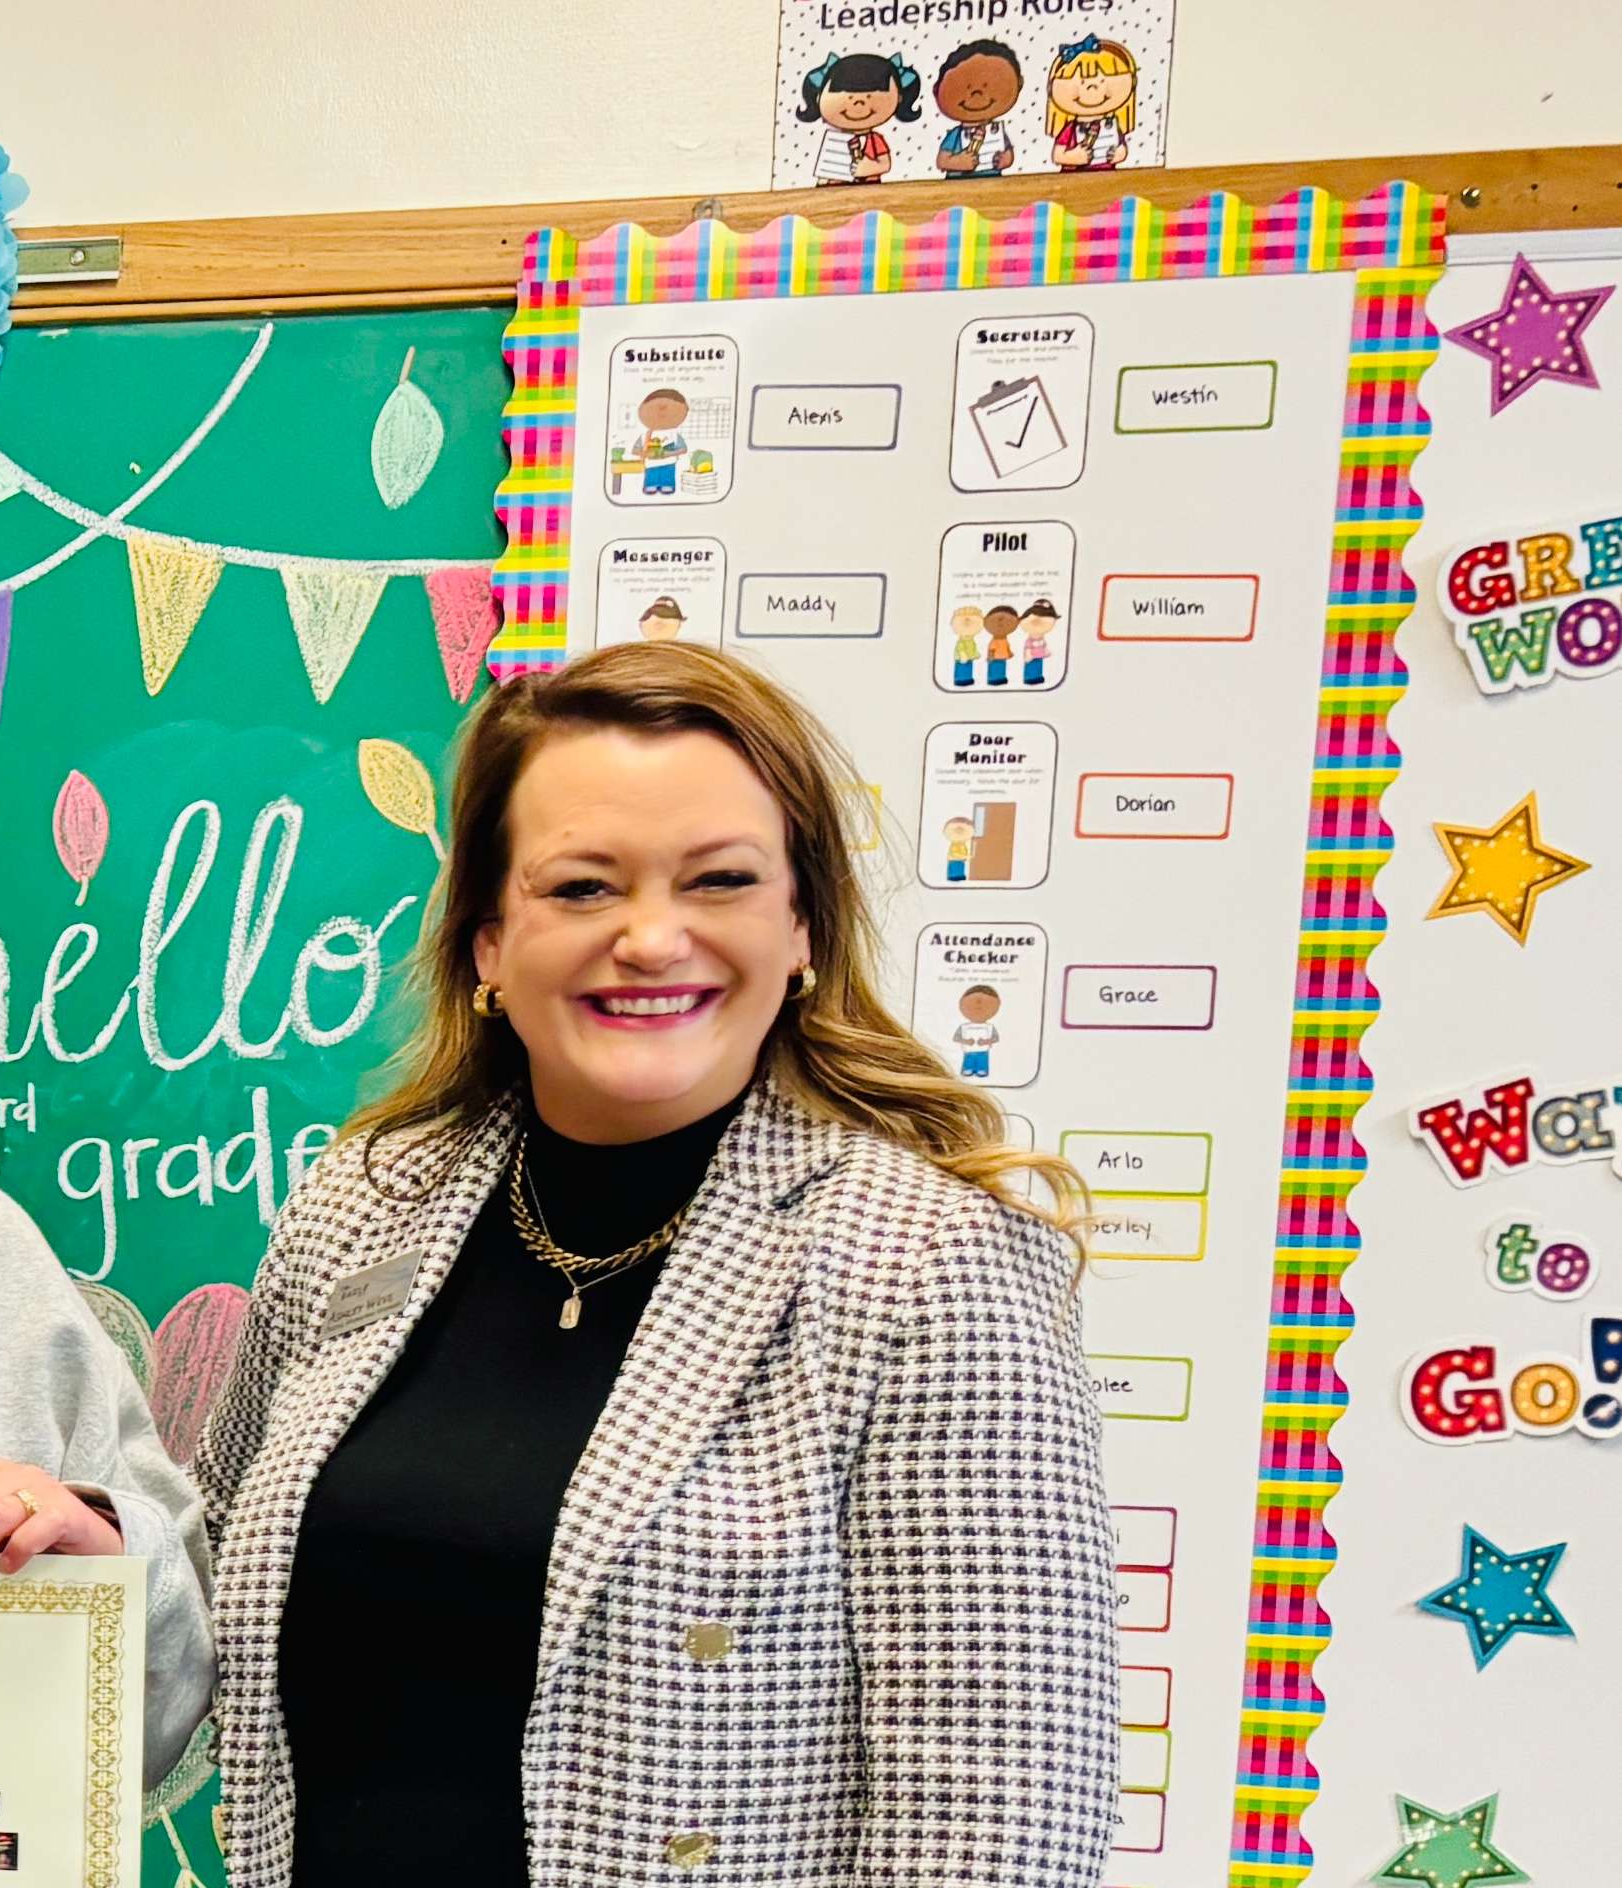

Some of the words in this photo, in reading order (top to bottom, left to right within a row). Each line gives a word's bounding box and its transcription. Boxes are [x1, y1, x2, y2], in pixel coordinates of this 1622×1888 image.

[821, 0, 1006, 30] Leadership
[976, 327, 1076, 344] Secretary
[624, 346, 725, 363] Substitute
[1152, 385, 1219, 405] Westin
[787, 407, 843, 425] Alexis
[982, 533, 1028, 552] Pilot
[613, 549, 715, 565] Messenger
[1448, 516, 1622, 616] GRE
[767, 594, 836, 622] Maddy
[1133, 598, 1205, 617] William
[1468, 598, 1622, 684] WO
[968, 733, 1014, 747] Door
[953, 749, 1027, 765] Monitor
[1116, 794, 1176, 812] Dorian
[930, 932, 1035, 948] Attendance
[944, 950, 1019, 965] Checker
[1099, 985, 1159, 1003] Grace
[1098, 1150, 1143, 1169] Arlo
[1496, 1223, 1590, 1293] to
